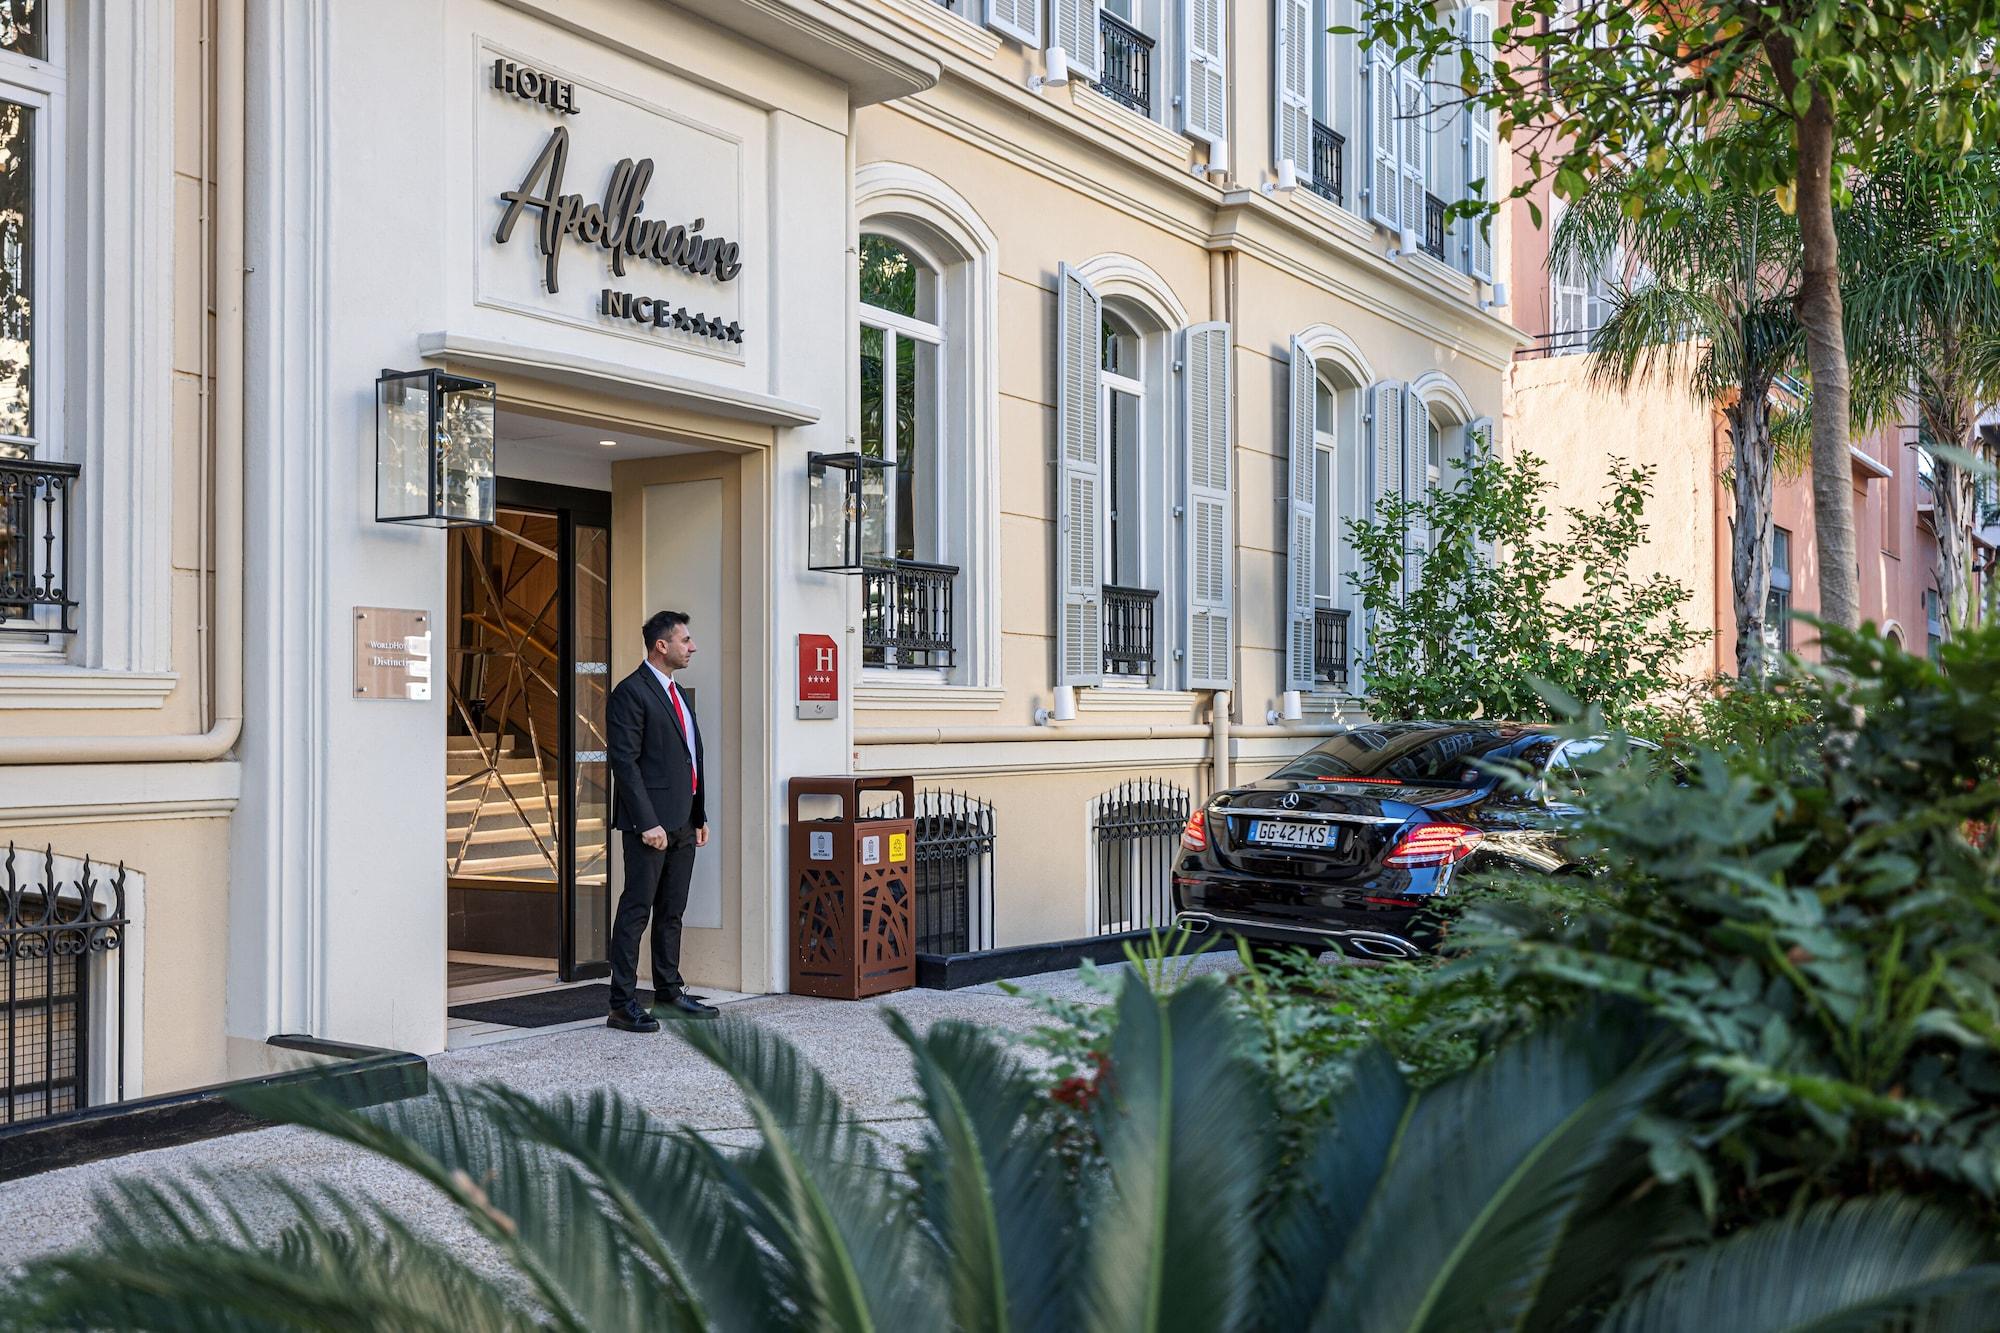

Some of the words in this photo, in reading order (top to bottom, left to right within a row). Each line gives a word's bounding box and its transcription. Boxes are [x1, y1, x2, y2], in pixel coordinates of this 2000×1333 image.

[494, 58, 580, 115] HOTEL
[495, 126, 742, 293] Apollinaire
[601, 288, 670, 328] NICE
[815, 647, 835, 672] H
[1259, 823, 1326, 844] GG-421-KS
